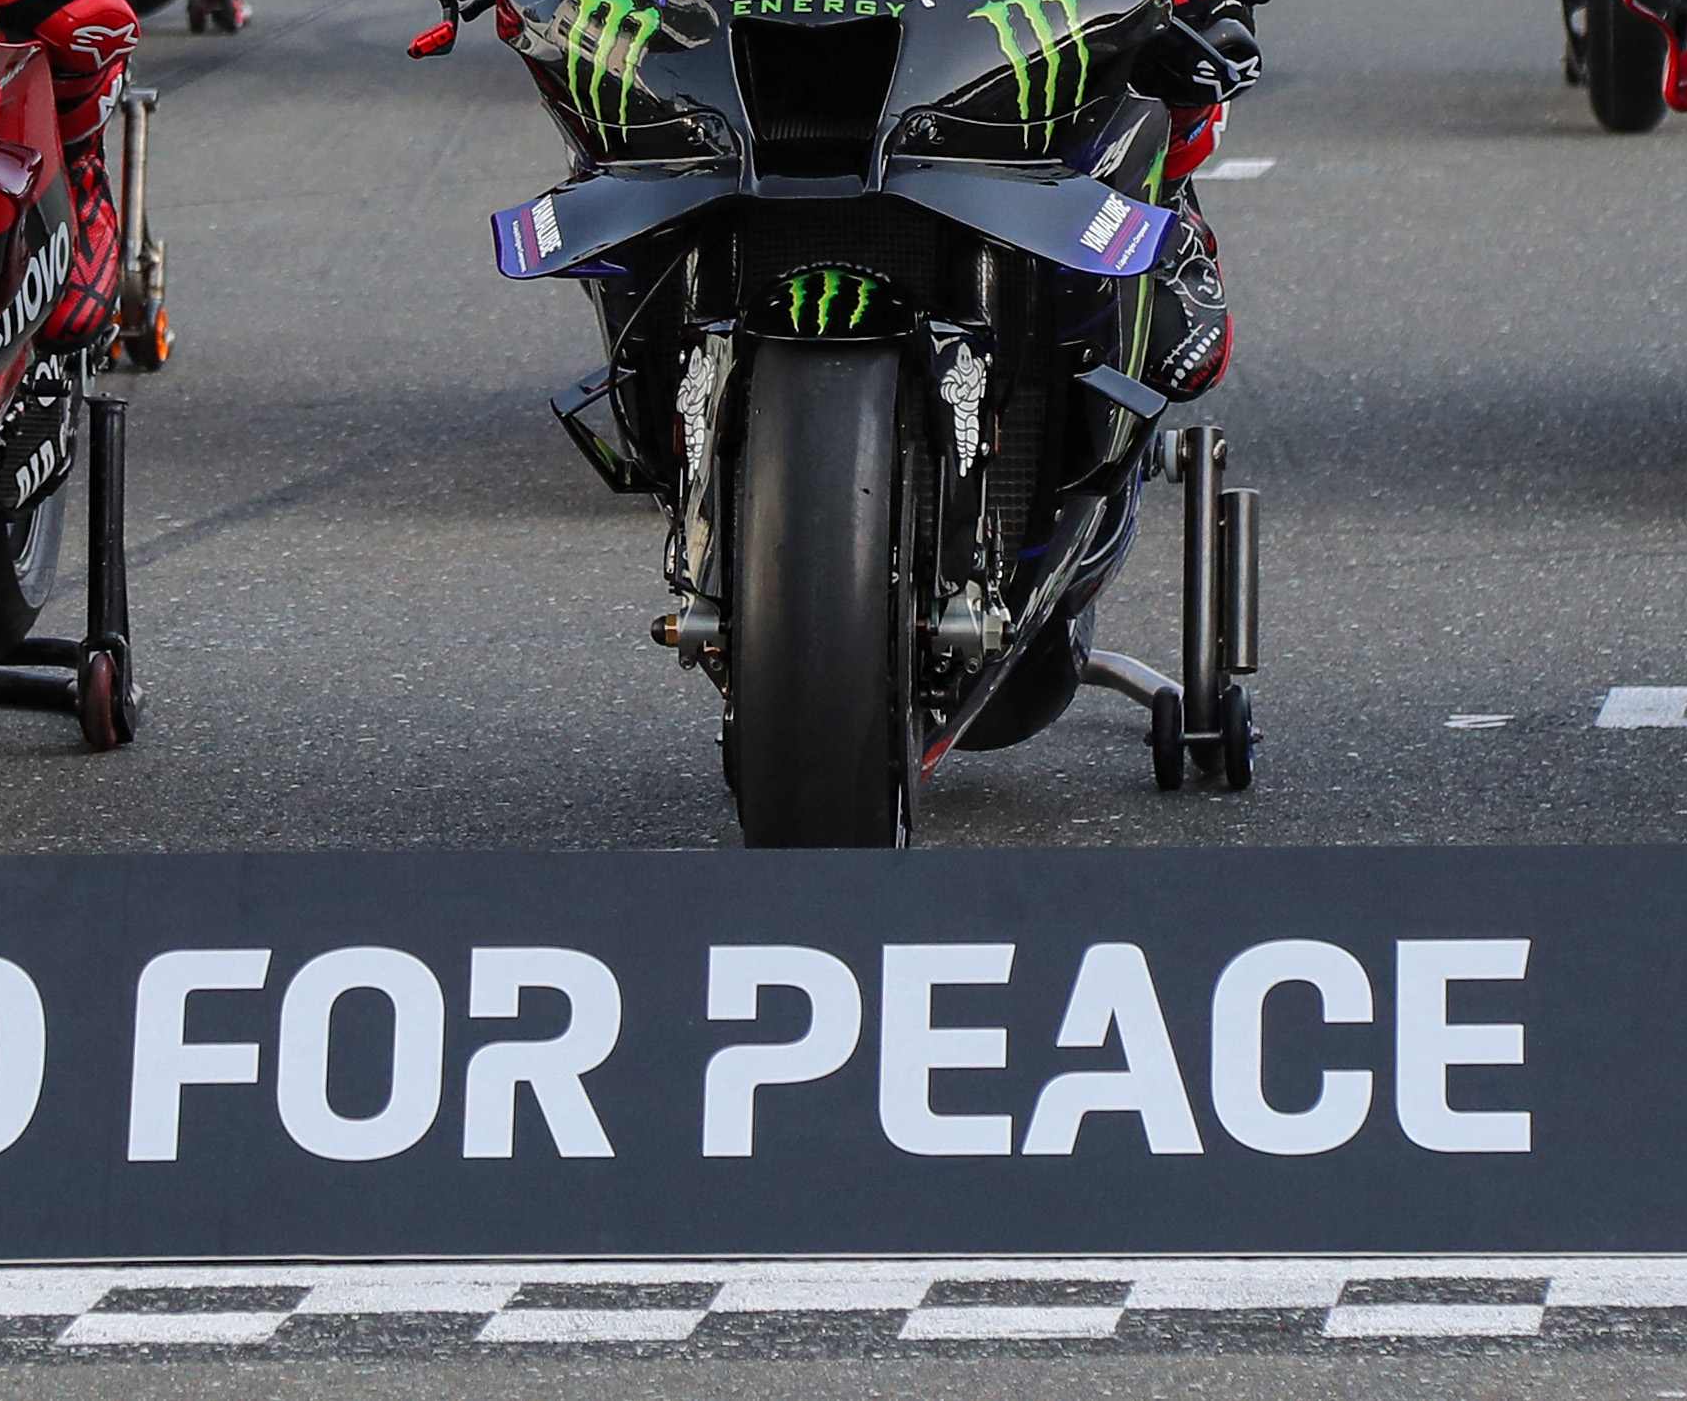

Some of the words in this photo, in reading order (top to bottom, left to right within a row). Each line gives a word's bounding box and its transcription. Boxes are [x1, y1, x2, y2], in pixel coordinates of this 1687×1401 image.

[530, 194, 560, 260] YAMALUBE
[1078, 193, 1134, 256] YAMALUBE
[126, 945, 624, 1162] FOR
[703, 938, 1532, 1158] PEACE
